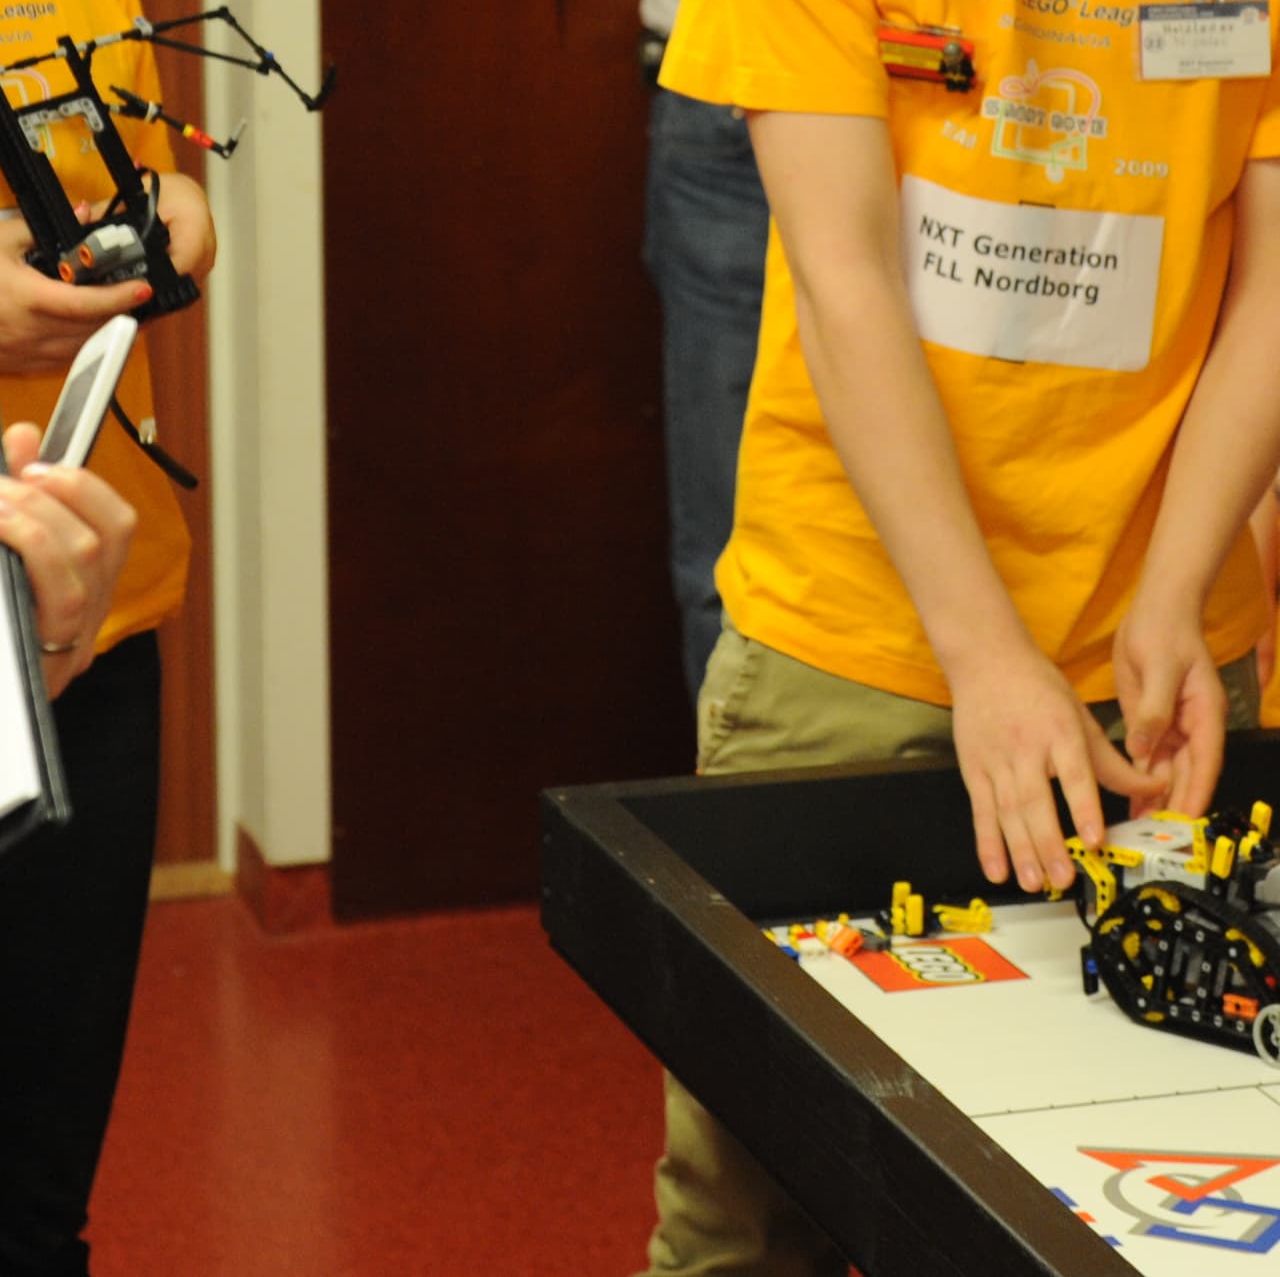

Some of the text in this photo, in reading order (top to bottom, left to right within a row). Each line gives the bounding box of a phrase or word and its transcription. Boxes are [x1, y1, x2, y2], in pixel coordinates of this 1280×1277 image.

[1114, 159, 1169, 179] 2009
[919, 216, 1119, 270] NXT Generation
[923, 252, 1099, 306] FLL Nordborg
